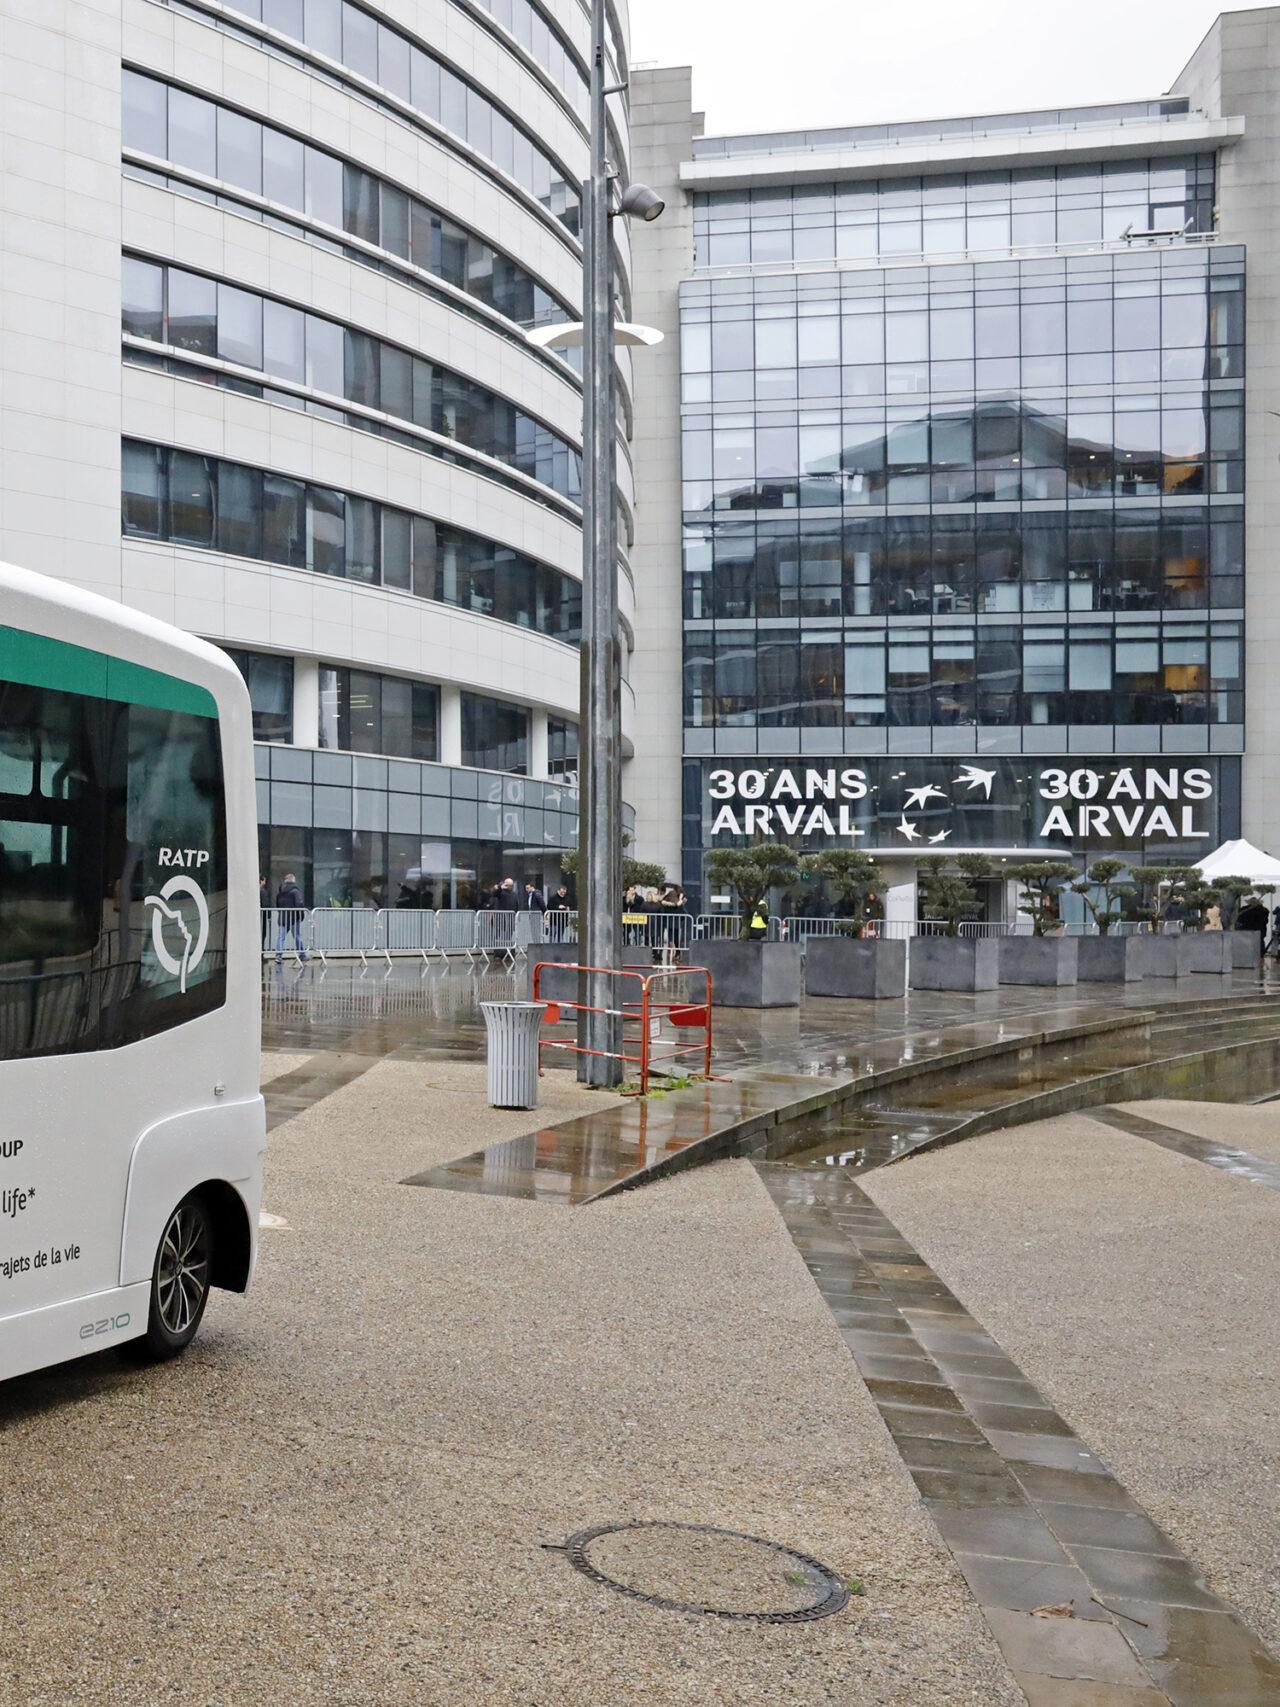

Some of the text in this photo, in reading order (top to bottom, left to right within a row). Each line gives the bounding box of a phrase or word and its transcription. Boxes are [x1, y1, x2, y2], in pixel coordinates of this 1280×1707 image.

[708, 769, 867, 799] 30 ANS
[1039, 768, 1213, 799] 30 ANS
[710, 805, 865, 836] ARVAL
[1039, 805, 1210, 837] ARVAL
[158, 847, 210, 868] RATP
[33, 1250, 48, 1269] de
[50, 1246, 62, 1265] la
[63, 1243, 81, 1261] vie
